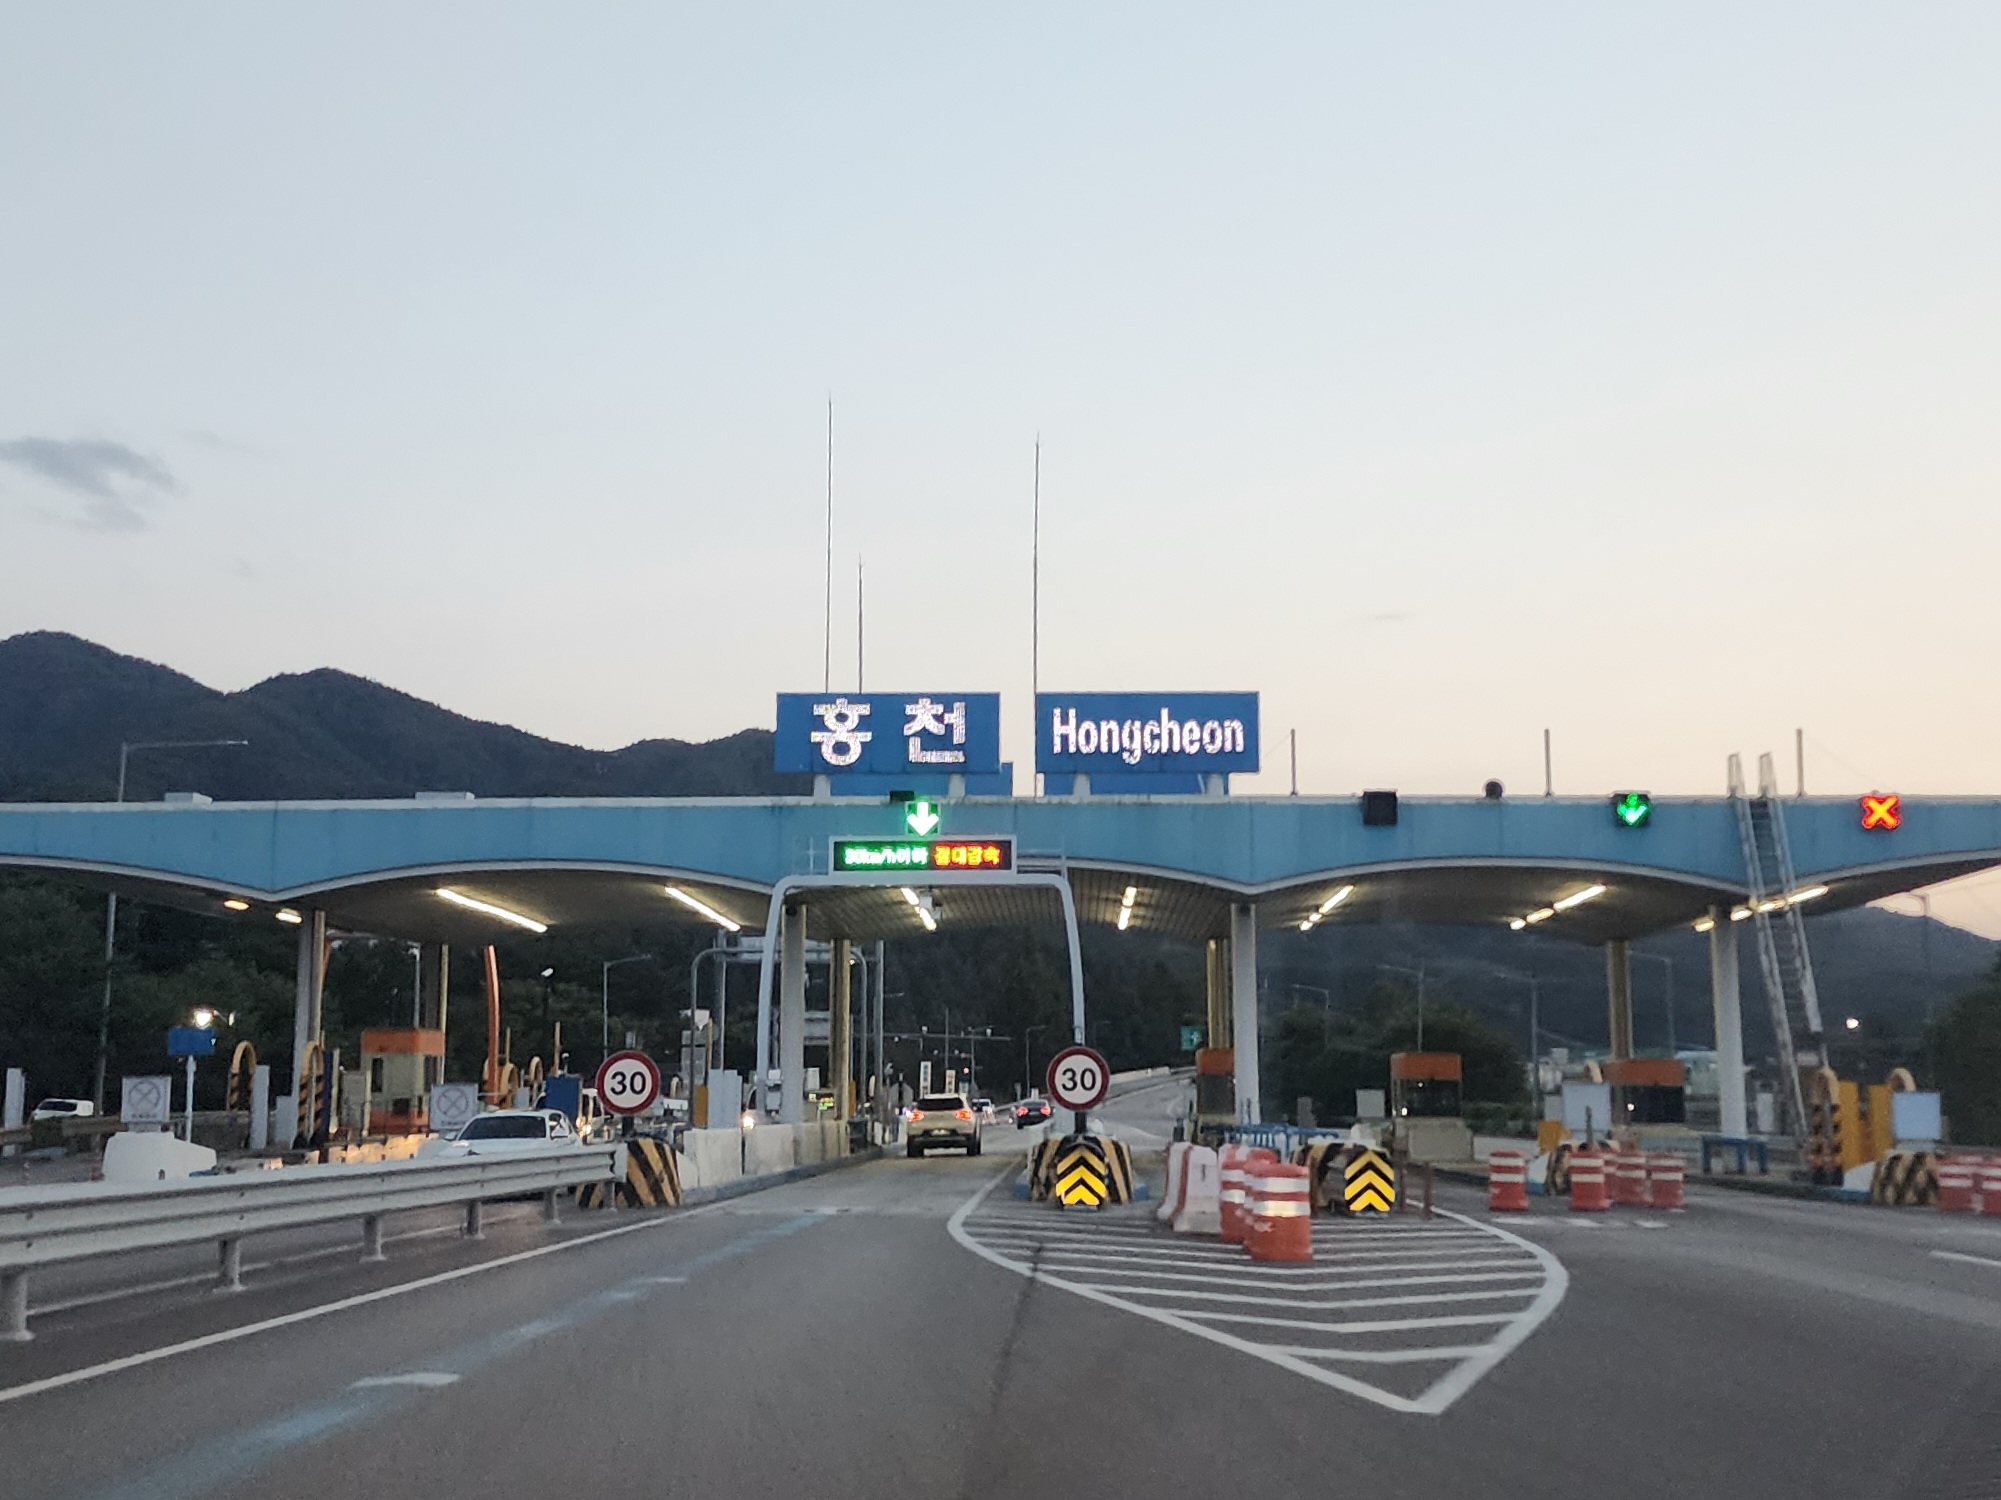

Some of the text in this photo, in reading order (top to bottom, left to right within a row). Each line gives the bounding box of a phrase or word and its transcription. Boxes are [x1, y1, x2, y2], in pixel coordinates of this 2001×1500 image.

[1053, 707, 1245, 765] Hongcheon
[610, 1071, 646, 1095] 30
[1061, 1067, 1097, 1091] 30
